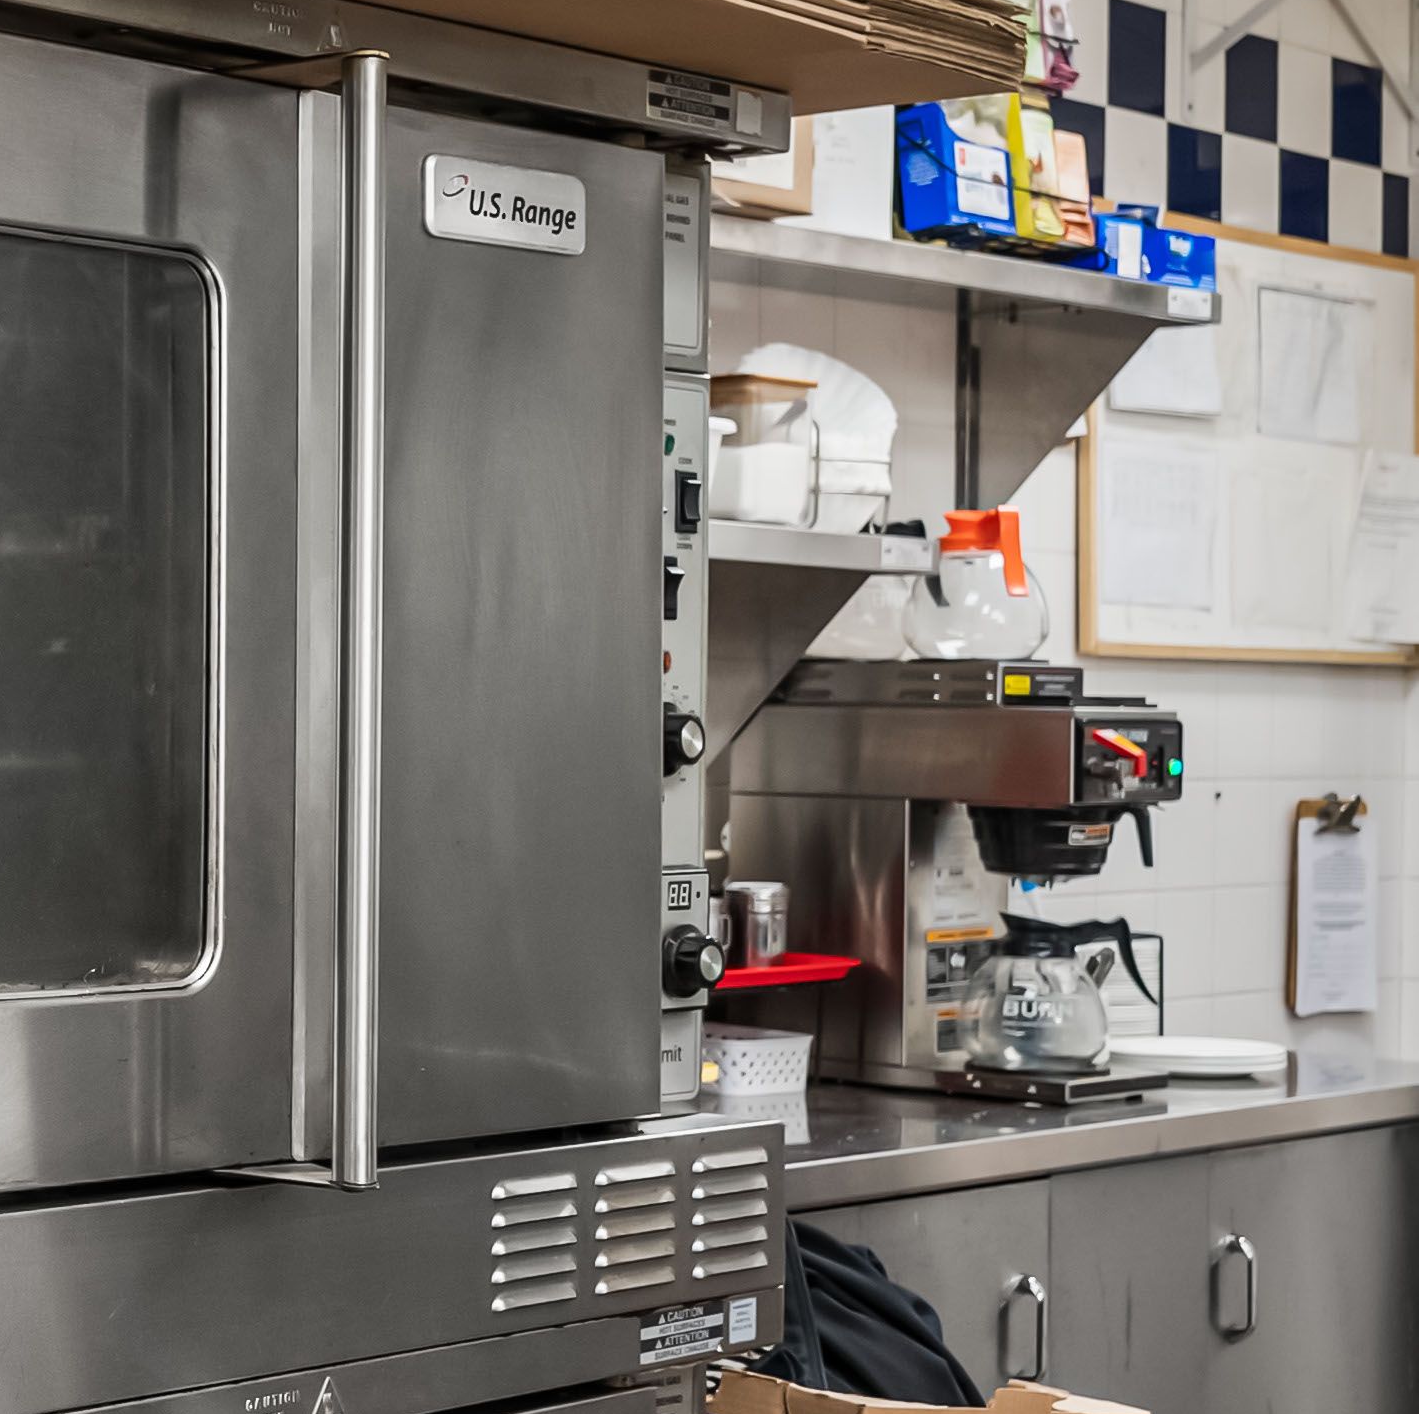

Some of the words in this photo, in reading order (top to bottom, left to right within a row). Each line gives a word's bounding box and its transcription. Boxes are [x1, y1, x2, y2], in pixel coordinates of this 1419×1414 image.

[469, 189, 507, 221] U.S.
[510, 195, 577, 235] Range
[666, 1305, 704, 1323] CAUTION
[664, 1329, 710, 1347] ATTENTION
